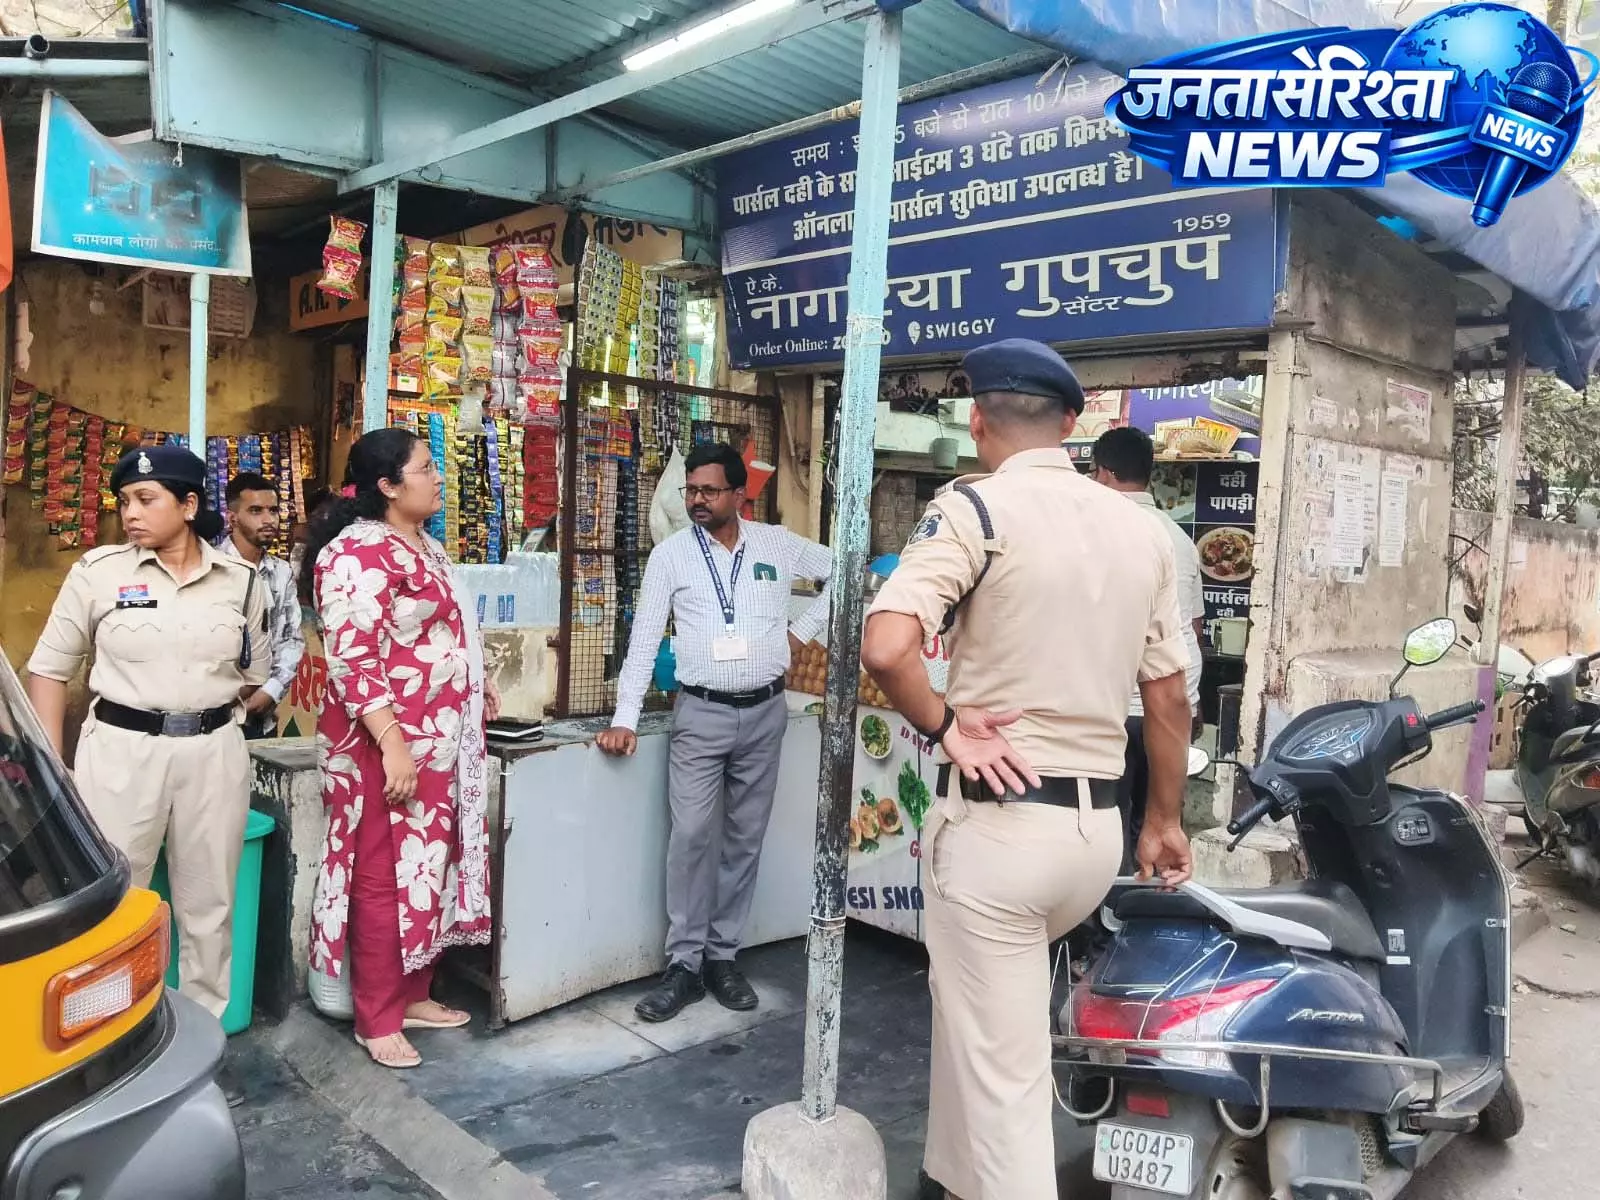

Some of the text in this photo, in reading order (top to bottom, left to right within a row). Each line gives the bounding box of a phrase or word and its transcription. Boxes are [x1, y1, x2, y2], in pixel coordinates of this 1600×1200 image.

[913, 110, 942, 138] बजे
[950, 103, 969, 131] से
[979, 98, 1013, 124] रात
[1025, 92, 1045, 113] 10
[791, 142, 831, 167] समय
[960, 145, 973, 169] 3
[981, 131, 1014, 162] घंटे
[1019, 126, 1059, 156] तक
[1064, 115, 1129, 147] क्रिस्प
[732, 171, 857, 215] पार्सल दही के सा
[889, 188, 945, 223] पार्सल
[949, 179, 1018, 220] सुविधा
[1023, 162, 1108, 199] उपलब्ध
[793, 211, 855, 242] ऑनला
[1172, 213, 1231, 233] 1959
[72, 233, 123, 248] कामयाब
[746, 273, 783, 296] ऐ.के.
[747, 234, 1231, 330] नागया गुपचुप
[1061, 296, 1123, 315] सेंटर
[749, 340, 781, 357] Order
[785, 338, 828, 354] Online:
[925, 317, 996, 339] SWIGGY
[1219, 471, 1248, 488] दही
[1210, 493, 1255, 514] पापड़ी
[1203, 589, 1249, 606] पार्सल
[882, 886, 925, 910] SNA
[1110, 1128, 1176, 1159] CG04P
[1108, 1154, 1174, 1187] U3487
